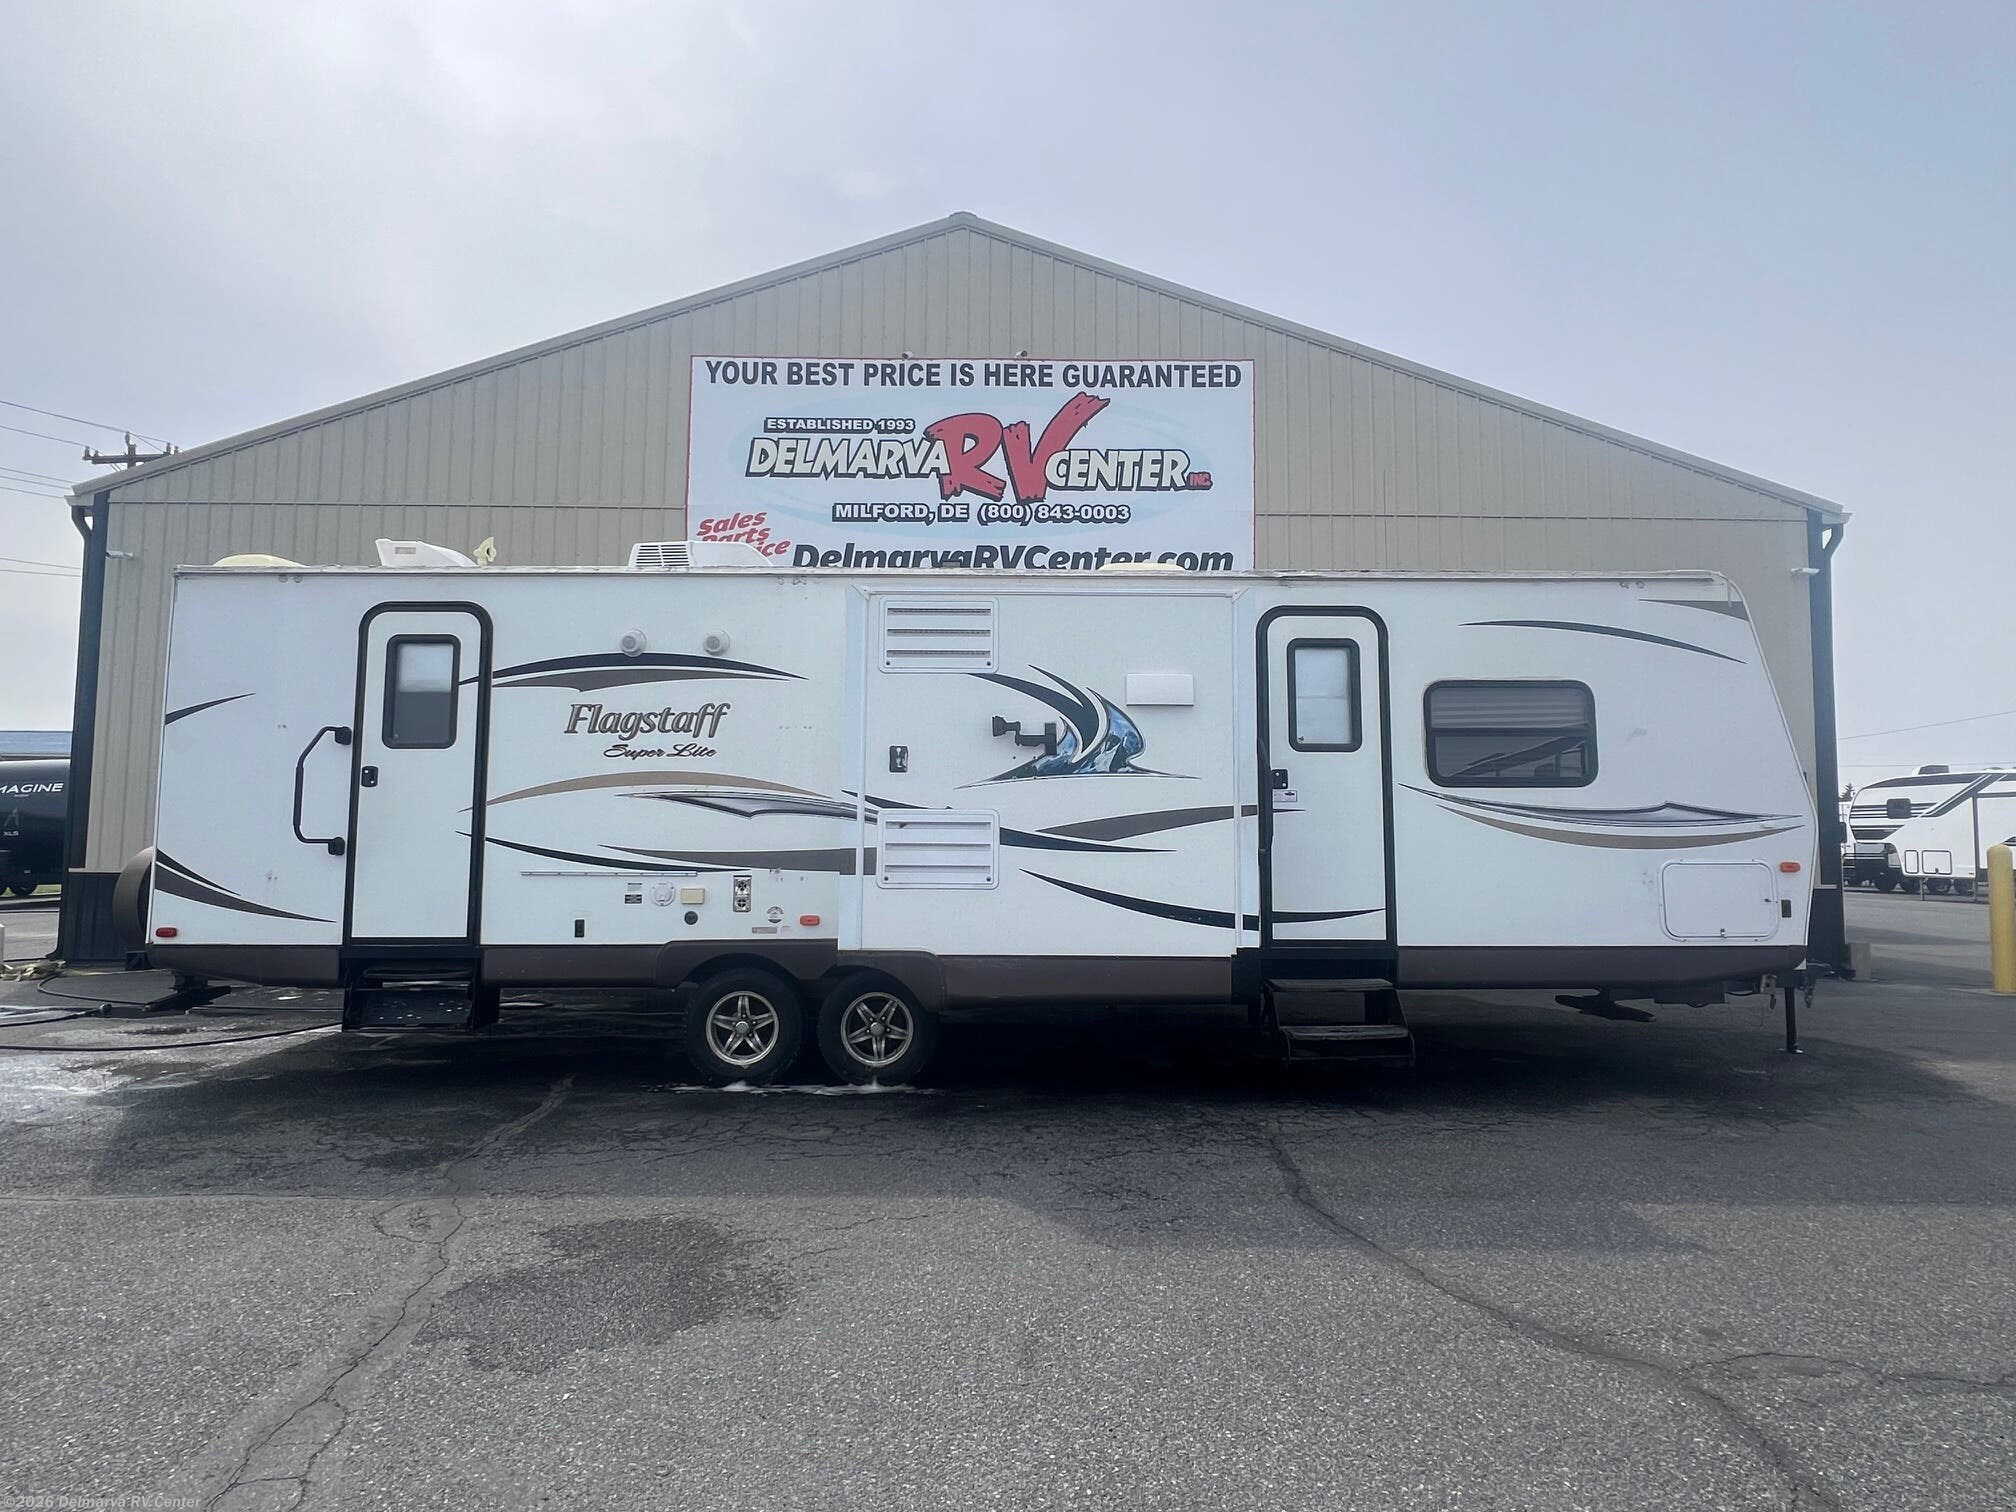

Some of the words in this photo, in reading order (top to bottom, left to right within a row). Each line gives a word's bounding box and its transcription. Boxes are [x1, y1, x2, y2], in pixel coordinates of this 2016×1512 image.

[705, 360, 778, 386] YOUR
[787, 362, 855, 387] BEST
[863, 363, 941, 387] PRICE
[951, 363, 975, 387] IS
[984, 363, 1054, 388] HERE
[1062, 364, 1242, 388] GUARANTEED
[764, 417, 874, 434] ESTABLISHED
[877, 418, 916, 434] 1993
[745, 437, 952, 480] DELMARVA
[923, 391, 1111, 504] RV
[1045, 448, 1190, 492] CENTER
[832, 503, 935, 525] MILFORD,
[937, 503, 969, 522] DE
[977, 504, 1032, 526] (800)
[1035, 504, 1131, 524] 843-0003
[793, 543, 1234, 570] DelmarvaRVCentercom
[564, 702, 732, 741] Flagstaff
[603, 743, 666, 760] Super
[667, 742, 718, 758] Lite
